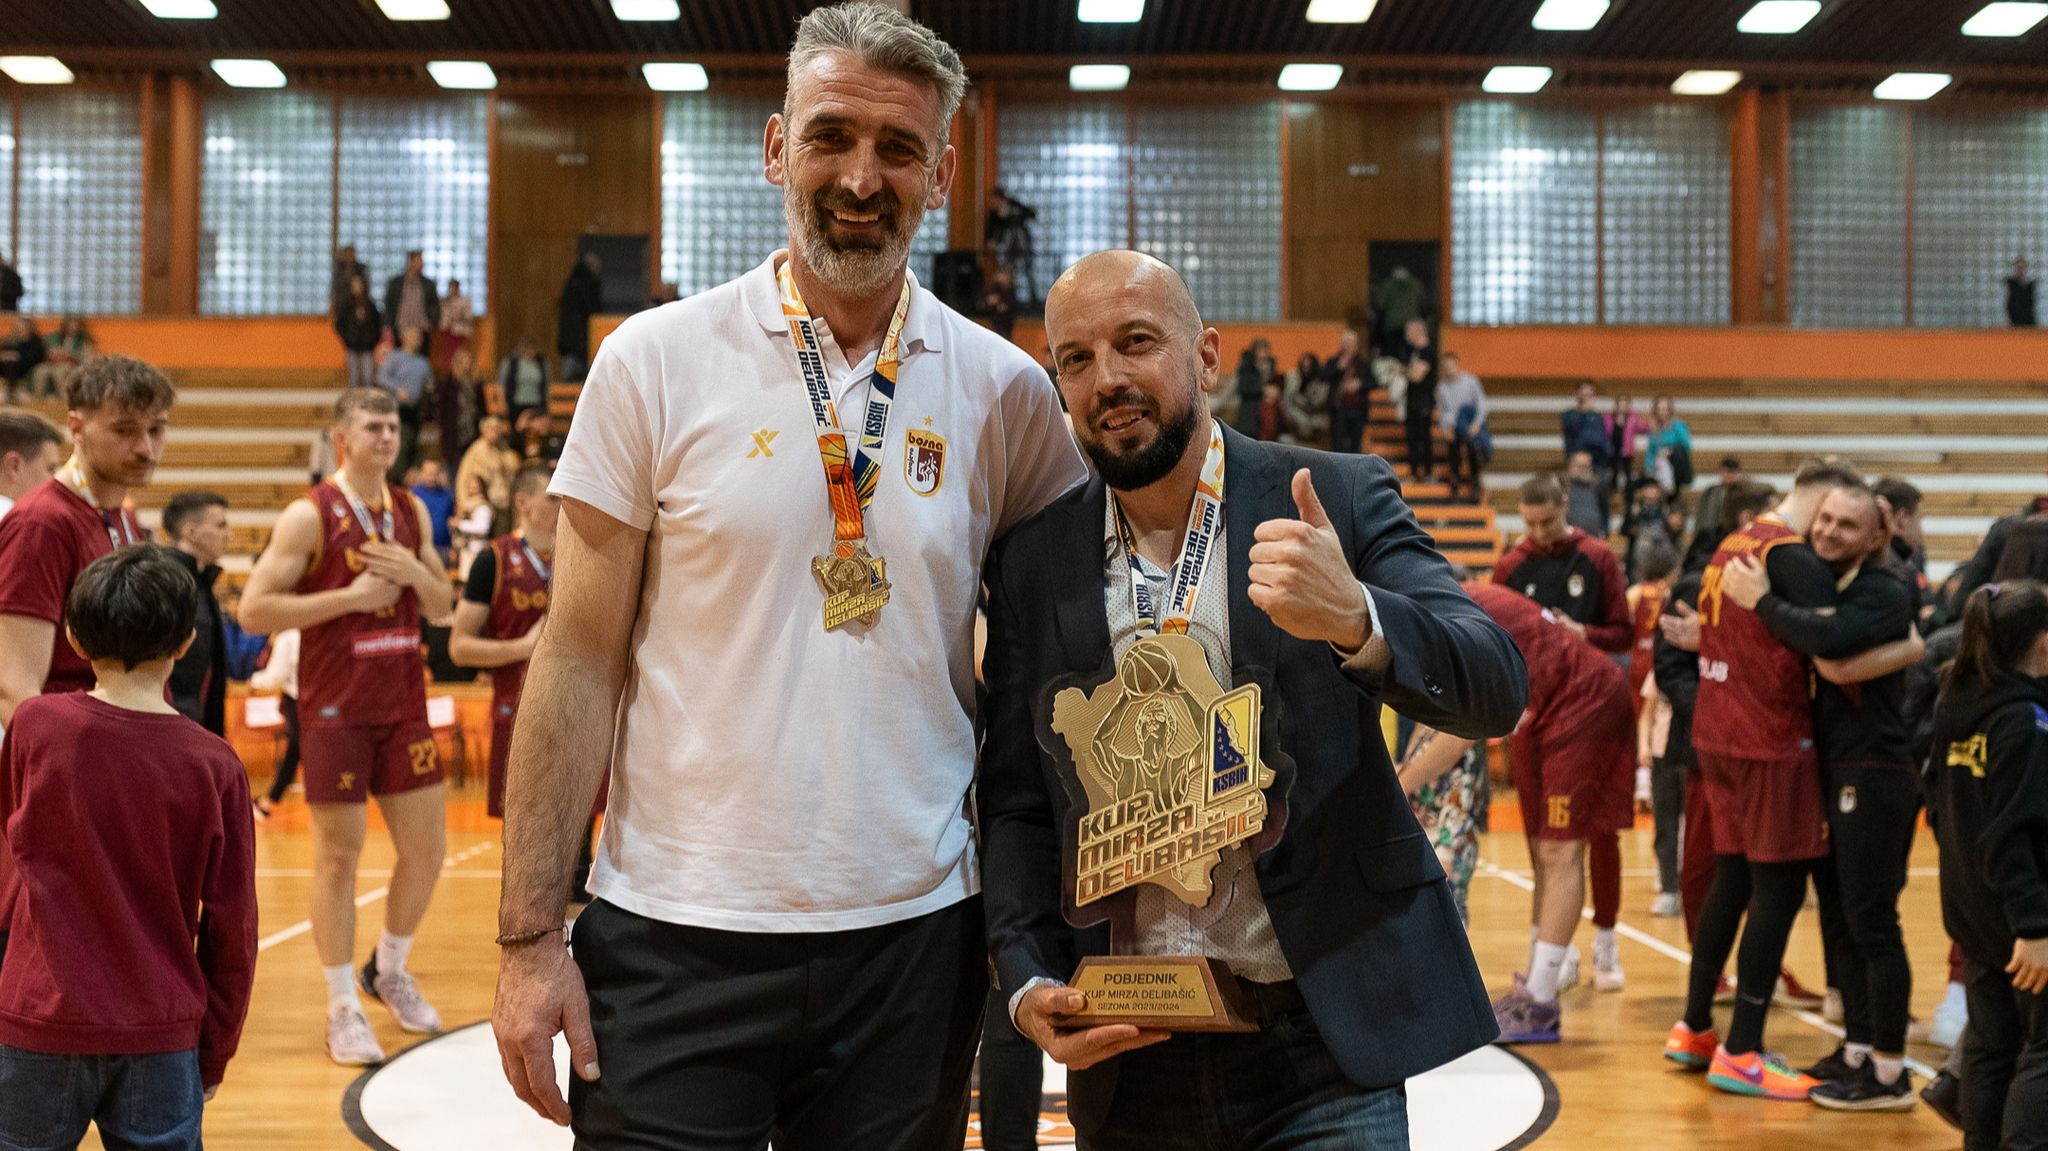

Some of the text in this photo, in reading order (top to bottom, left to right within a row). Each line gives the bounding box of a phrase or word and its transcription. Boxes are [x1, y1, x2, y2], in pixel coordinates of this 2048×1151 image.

[799, 320, 831, 400] KUP MIRZA
[798, 351, 831, 427] DELIBAŠIĆ
[864, 401, 885, 437] KSBIH
[909, 432, 943, 451] bosna
[1200, 501, 1216, 537] KUP
[1172, 530, 1199, 613] DELIBAŠIĆ
[1191, 536, 1208, 587] MIRZA
[825, 590, 850, 609] KUP
[826, 594, 866, 618] MIRZA
[1213, 765, 1249, 796] KSBIH
[1080, 793, 1150, 844] KUP
[1077, 795, 1262, 906] DELIBAŠIĆ
[1079, 803, 1197, 873] MIRZA
[1084, 987, 1196, 1000] KUP MIRZA DELIBAŠIĆ
[1104, 973, 1178, 985] POBJEDNIK
[1097, 1002, 1180, 1011] SEZONA 2023/2024
